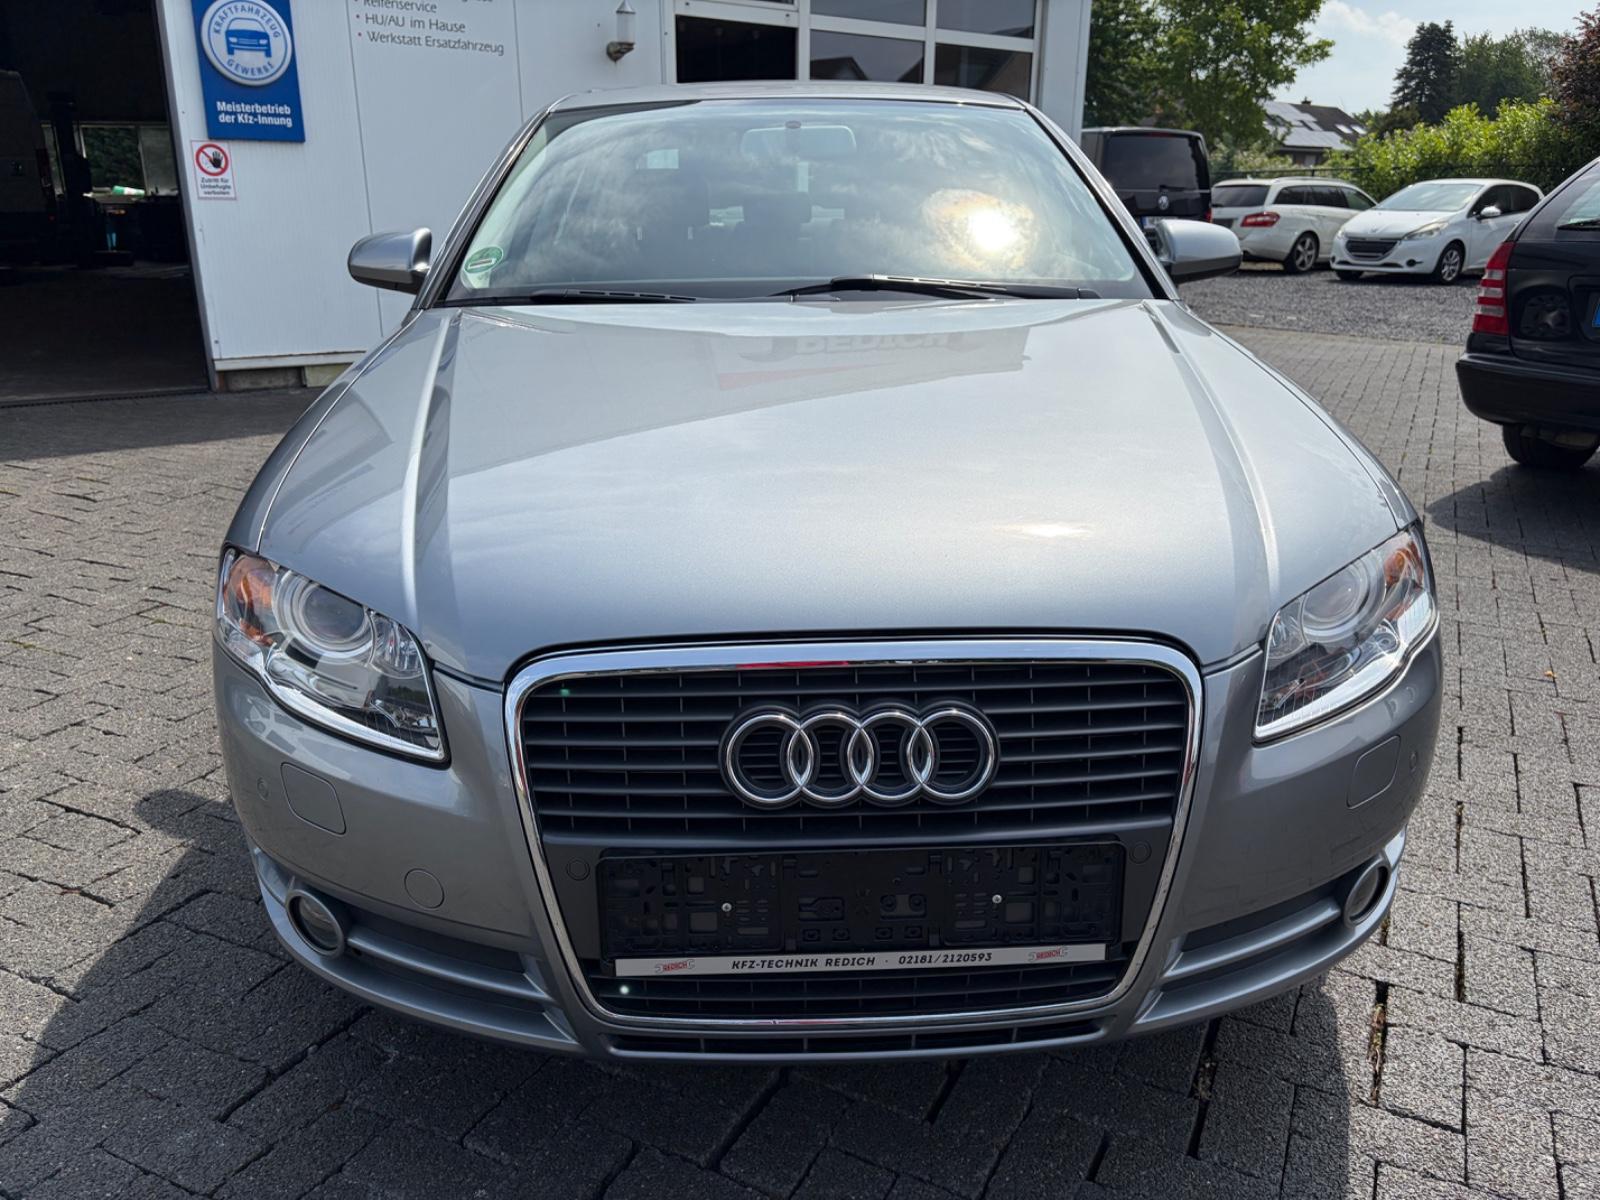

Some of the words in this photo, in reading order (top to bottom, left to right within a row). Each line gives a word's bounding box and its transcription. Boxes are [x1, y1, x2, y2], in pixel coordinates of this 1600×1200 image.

[213, 4, 281, 38] KRAFTFAHRZEUG
[365, 13, 405, 27] HU/AU
[410, 18, 426, 29] im
[429, 18, 466, 33] Hause
[367, 30, 422, 46] Werkstatt
[425, 35, 504, 56] Ersatzfahrzeug
[226, 59, 274, 76] GEWERBE
[216, 101, 291, 115] Meisterbetrieb
[218, 113, 236, 123] der
[237, 114, 293, 128] Kfz-Innung
[731, 958, 819, 970] KFZ-TECHNIK
[825, 956, 876, 968] REDICH
[898, 952, 993, 965] 02181/2120593
